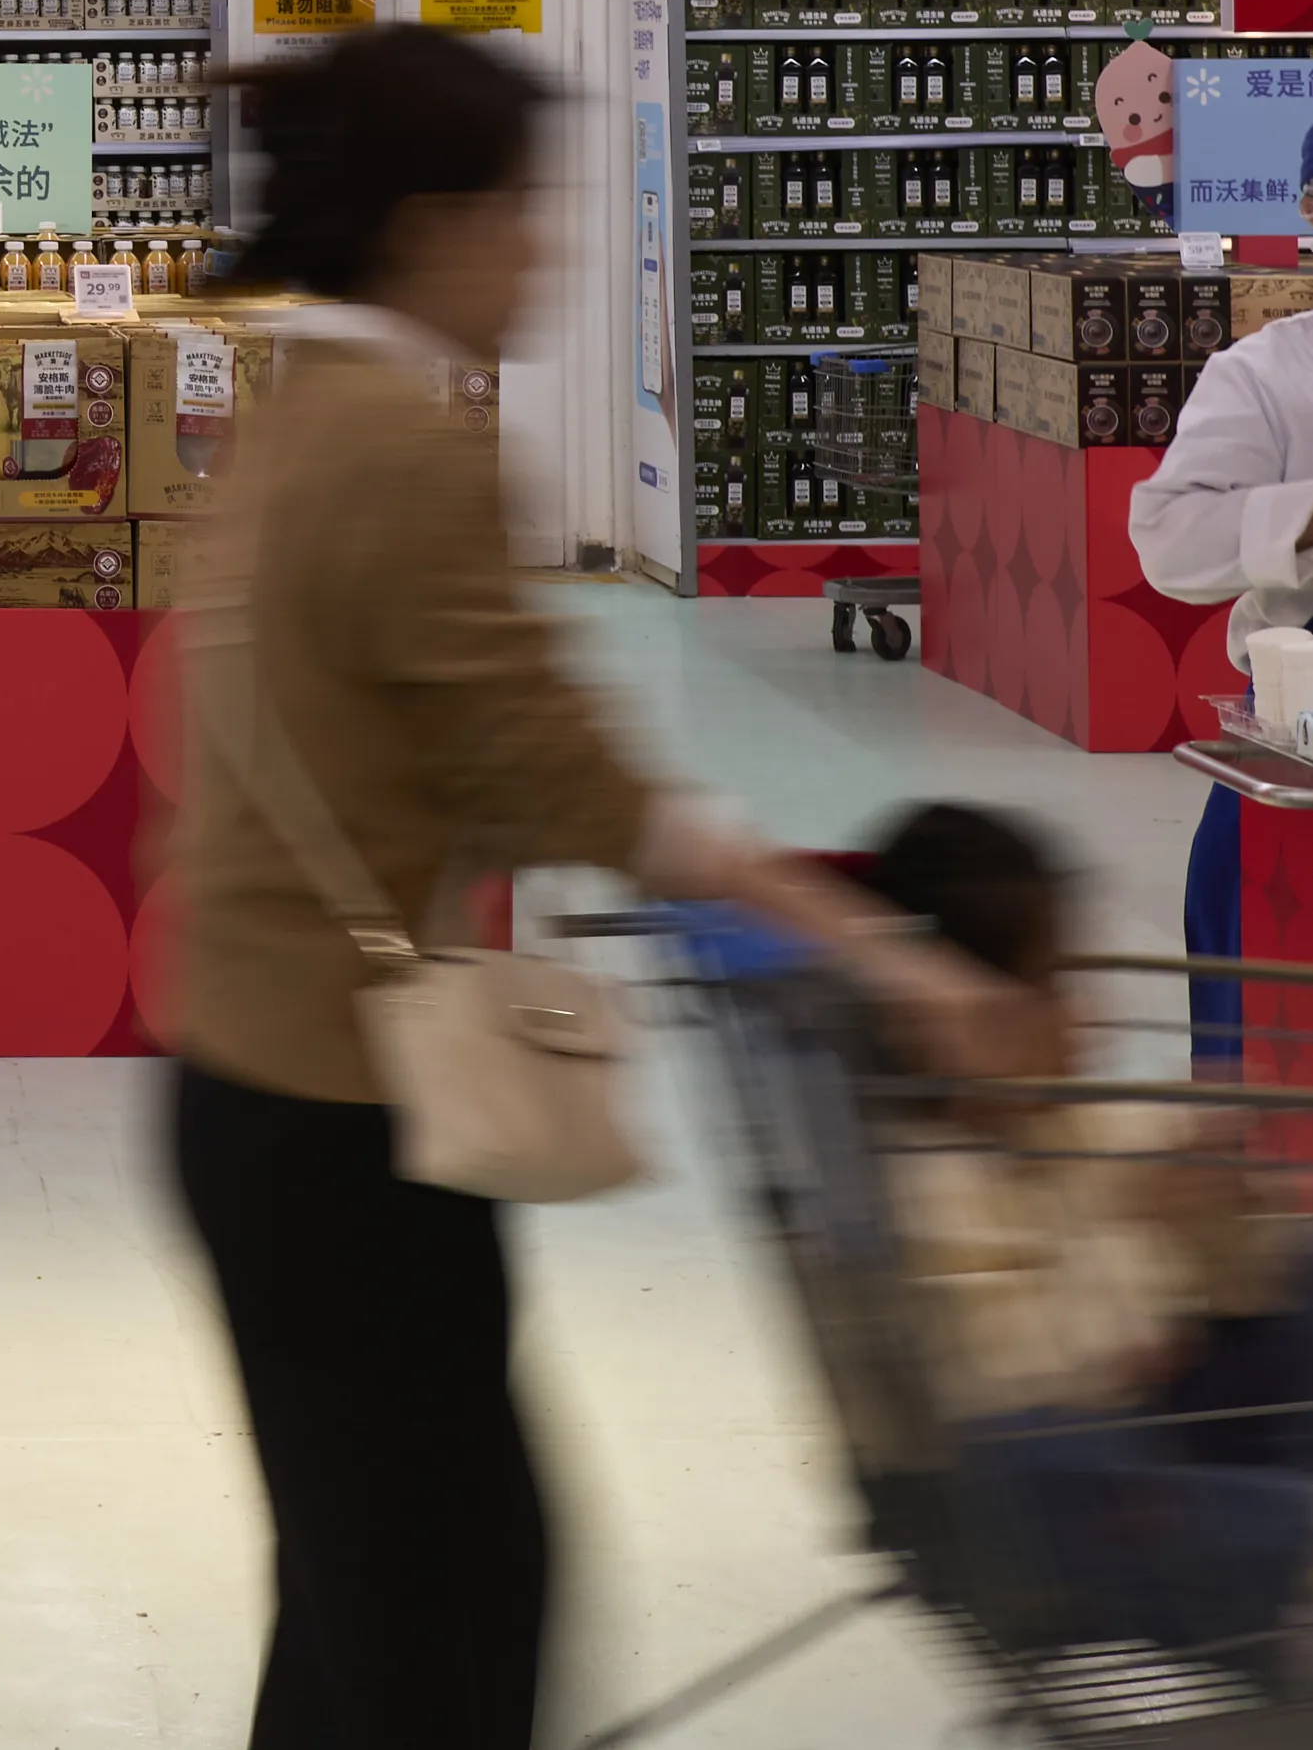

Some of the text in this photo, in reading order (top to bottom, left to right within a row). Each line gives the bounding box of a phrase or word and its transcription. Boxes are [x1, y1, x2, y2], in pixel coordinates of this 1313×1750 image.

[1246, 69, 1313, 98] 爱是
[86, 283, 121, 296] 29.99
[38, 372, 69, 383] 安格斯
[189, 374, 219, 385] 安格斯
